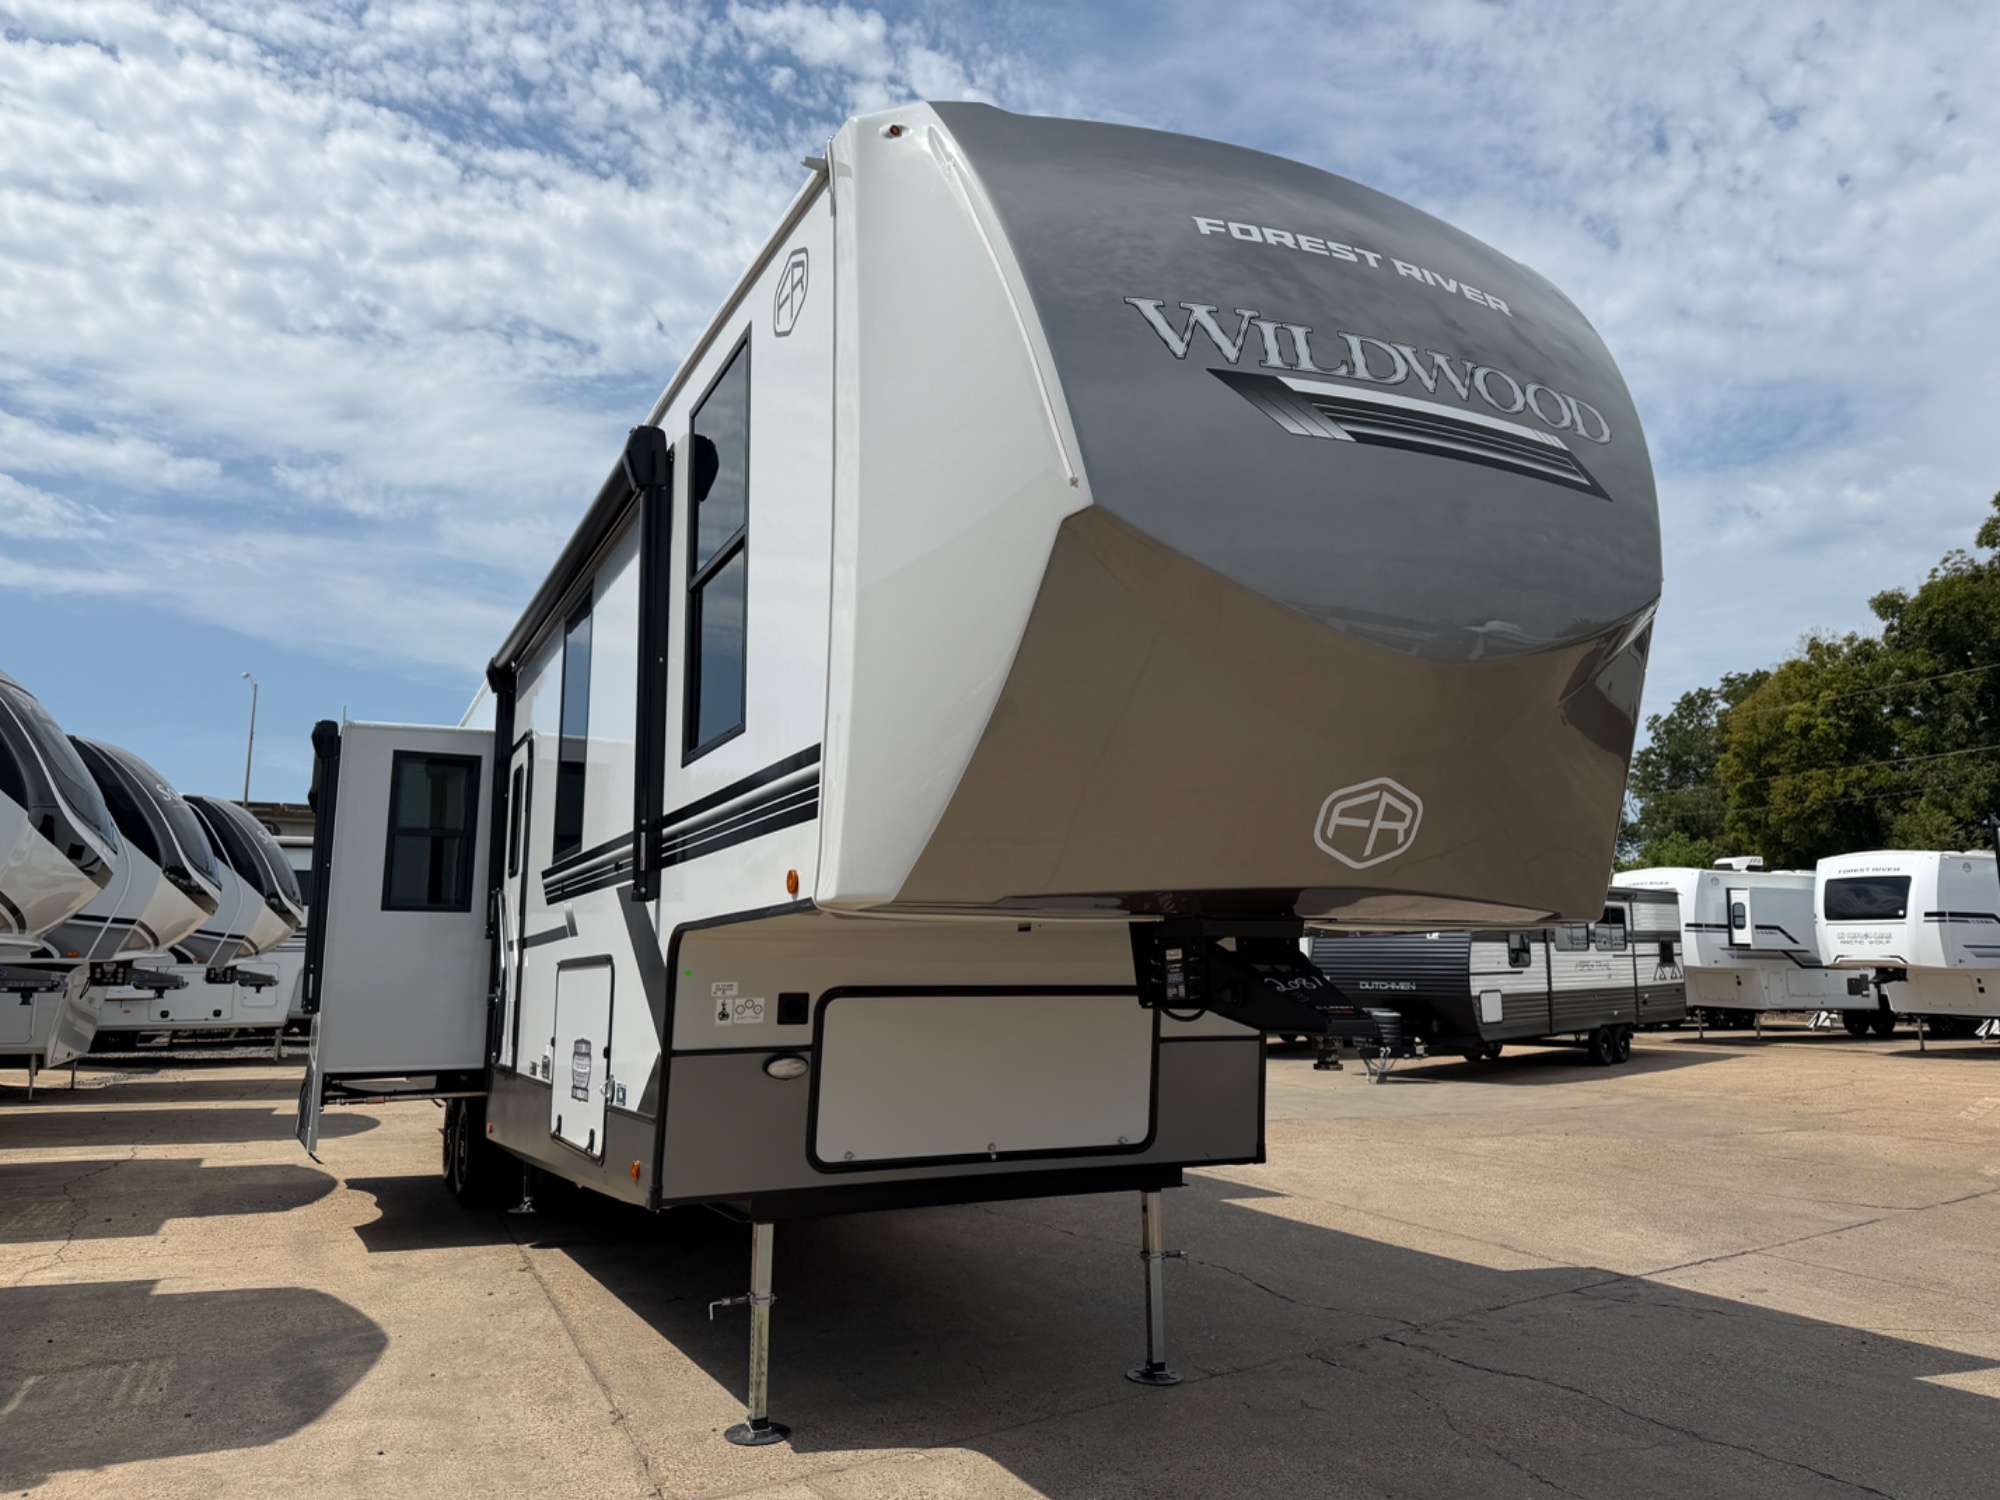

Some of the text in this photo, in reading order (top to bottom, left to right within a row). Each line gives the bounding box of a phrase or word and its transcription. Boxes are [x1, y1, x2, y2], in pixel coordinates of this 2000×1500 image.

[1192, 216, 1513, 317] FOREST RIVER
[1123, 296, 1612, 445] WILDWOOD
[1359, 981, 1417, 991] DUTCHMEN
